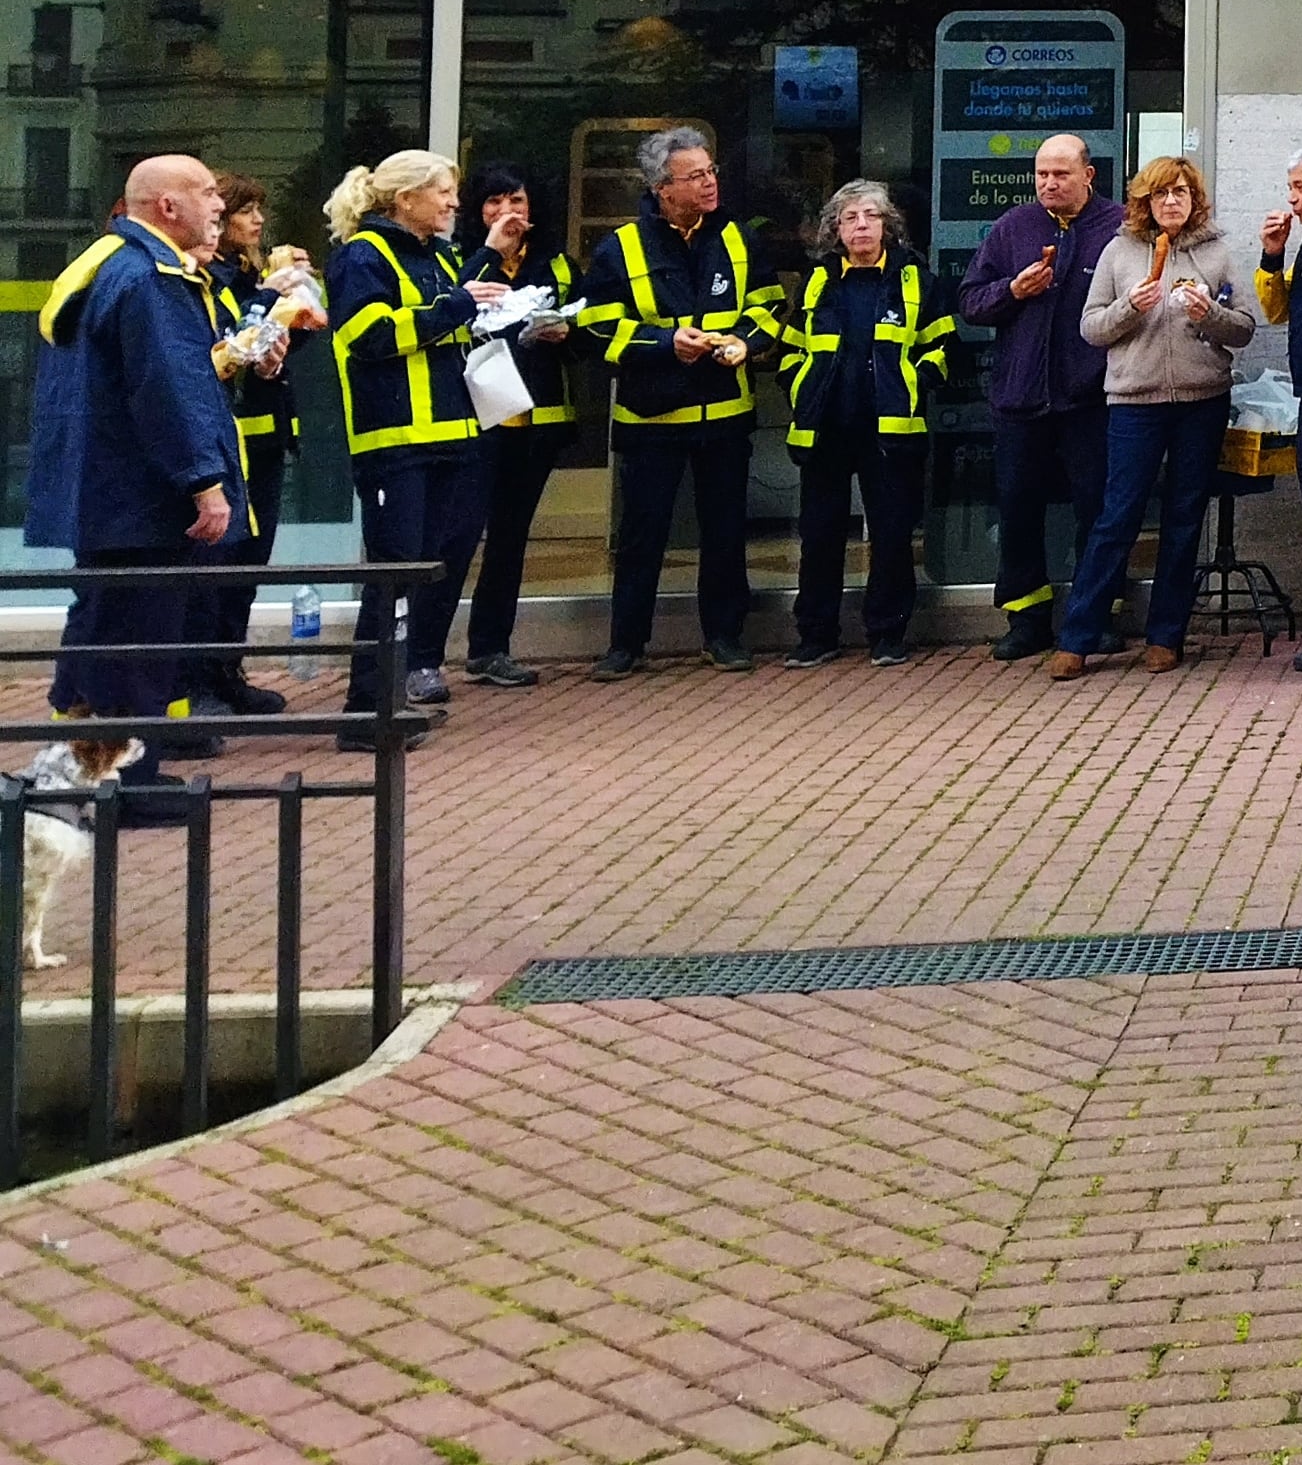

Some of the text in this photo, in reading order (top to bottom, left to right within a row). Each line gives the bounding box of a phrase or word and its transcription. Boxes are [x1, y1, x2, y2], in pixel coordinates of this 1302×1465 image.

[1012, 48, 1075, 62] CORREOS
[1046, 80, 1088, 96] hasta
[963, 101, 1013, 117] donde
[1037, 101, 1094, 119] quieras
[971, 170, 1035, 185] Encuentr
[968, 189, 991, 205] de
[994, 189, 1008, 205] lo
